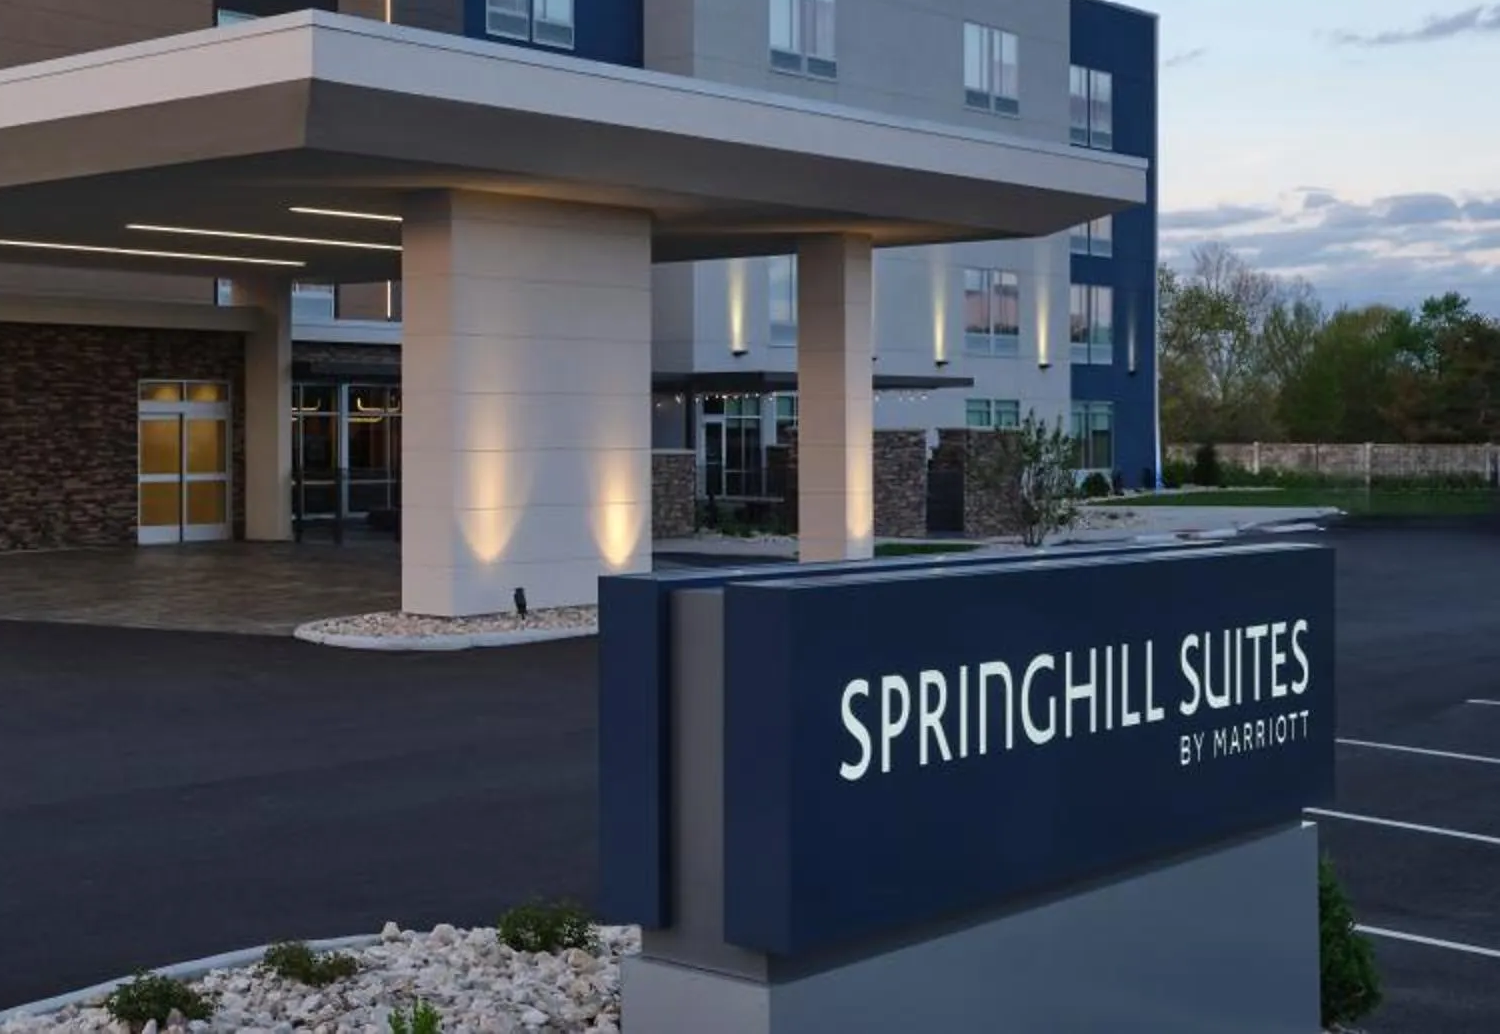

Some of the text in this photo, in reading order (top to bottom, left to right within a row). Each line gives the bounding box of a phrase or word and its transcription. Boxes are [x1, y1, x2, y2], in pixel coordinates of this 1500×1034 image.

[839, 619, 1309, 781] SPRINGHILL SUITES
[1180, 709, 1309, 767] BY MARRIOTT
